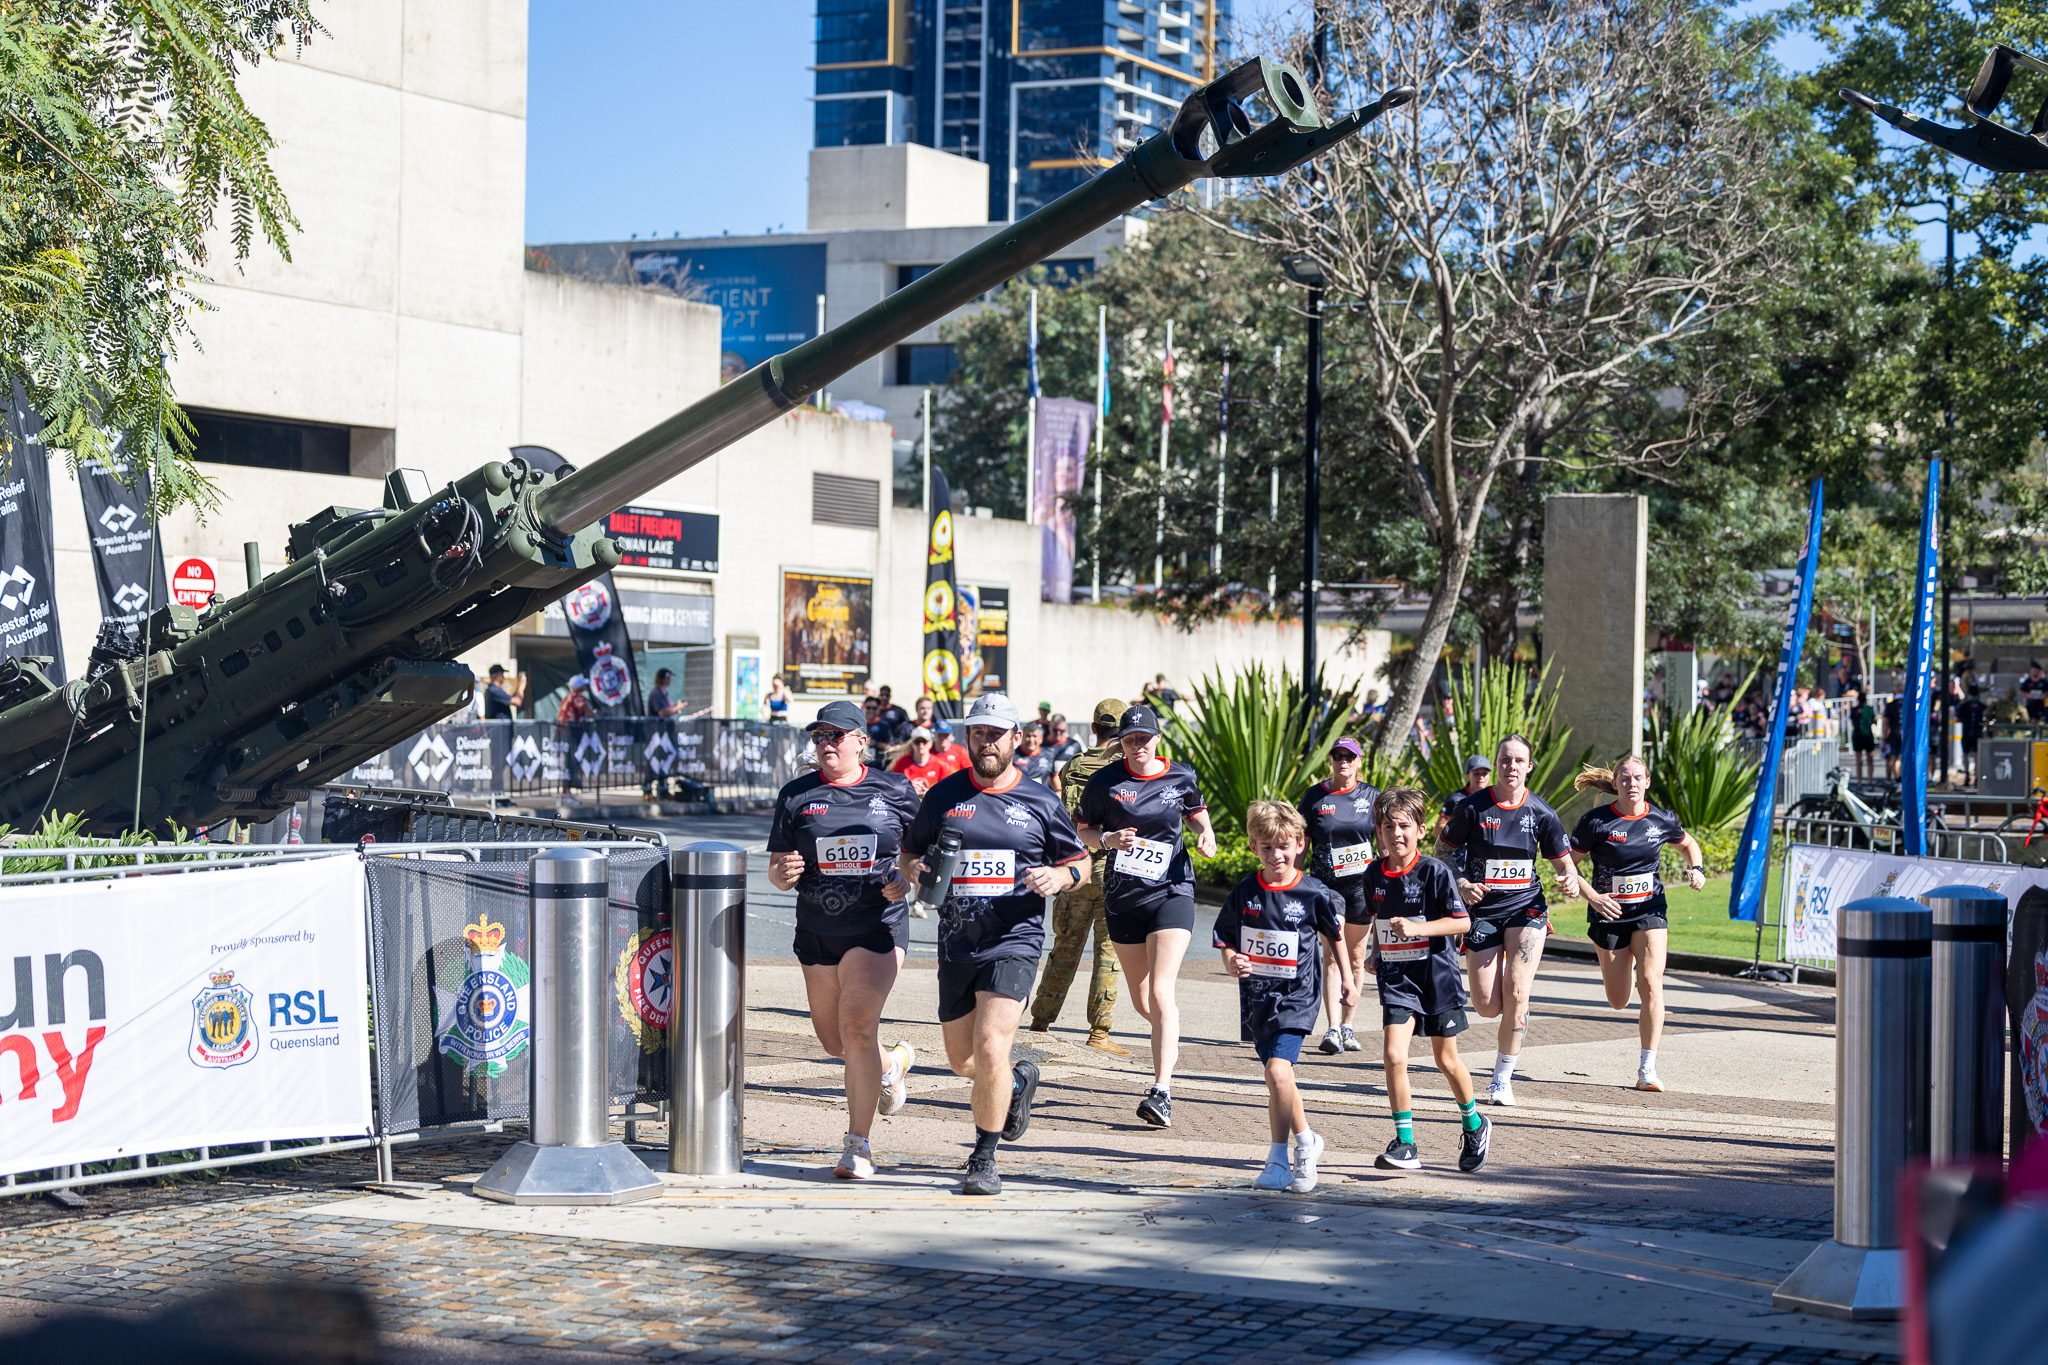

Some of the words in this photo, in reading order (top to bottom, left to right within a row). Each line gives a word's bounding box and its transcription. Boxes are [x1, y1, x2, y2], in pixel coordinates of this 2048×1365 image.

[703, 287, 772, 308] CIENT
[721, 310, 760, 328] YPT
[0, 500, 18, 517] alia
[105, 542, 142, 555] Australia
[648, 539, 674, 555] LAKE
[187, 565, 202, 578] NO
[0, 615, 29, 634] saster
[650, 608, 675, 626] ARTS
[5, 622, 49, 648] Australia
[1114, 793, 1137, 804] Army
[1120, 788, 1137, 797] Run
[803, 808, 829, 816] Army
[809, 803, 829, 811] Run
[872, 808, 888, 816] Army
[946, 808, 975, 819] Army
[955, 802, 976, 811] Run
[1006, 817, 1028, 829] Army
[1608, 835, 1627, 843] Army
[1612, 830, 1628, 838] Run
[825, 846, 870, 861] 6103
[1124, 847, 1164, 864] 9725
[1338, 850, 1367, 864] 5026
[960, 861, 1006, 876] 7558
[1492, 867, 1526, 879] 7194
[1618, 881, 1649, 893] 6970
[1810, 886, 1831, 915] RSL
[1285, 914, 1301, 924] Army
[210, 938, 247, 955] Proudly
[249, 930, 301, 948] sponsored
[303, 930, 315, 943] by
[1382, 930, 1420, 944] 75
[638, 937, 672, 964] QUEEN
[1247, 938, 1289, 958] 7560
[0, 949, 106, 1032] un
[458, 973, 516, 1015] QUEENSLAND
[633, 987, 650, 1013] FIRE
[268, 990, 338, 1027] RSL
[465, 1021, 509, 1042] POLICE
[212, 1040, 238, 1052] LEAGUE
[270, 1033, 340, 1051] Queensland
[450, 1038, 467, 1054] WITH
[493, 1047, 506, 1058] WE
[505, 1031, 527, 1050] SERVE
[207, 1052, 242, 1064] AUSTRALIA
